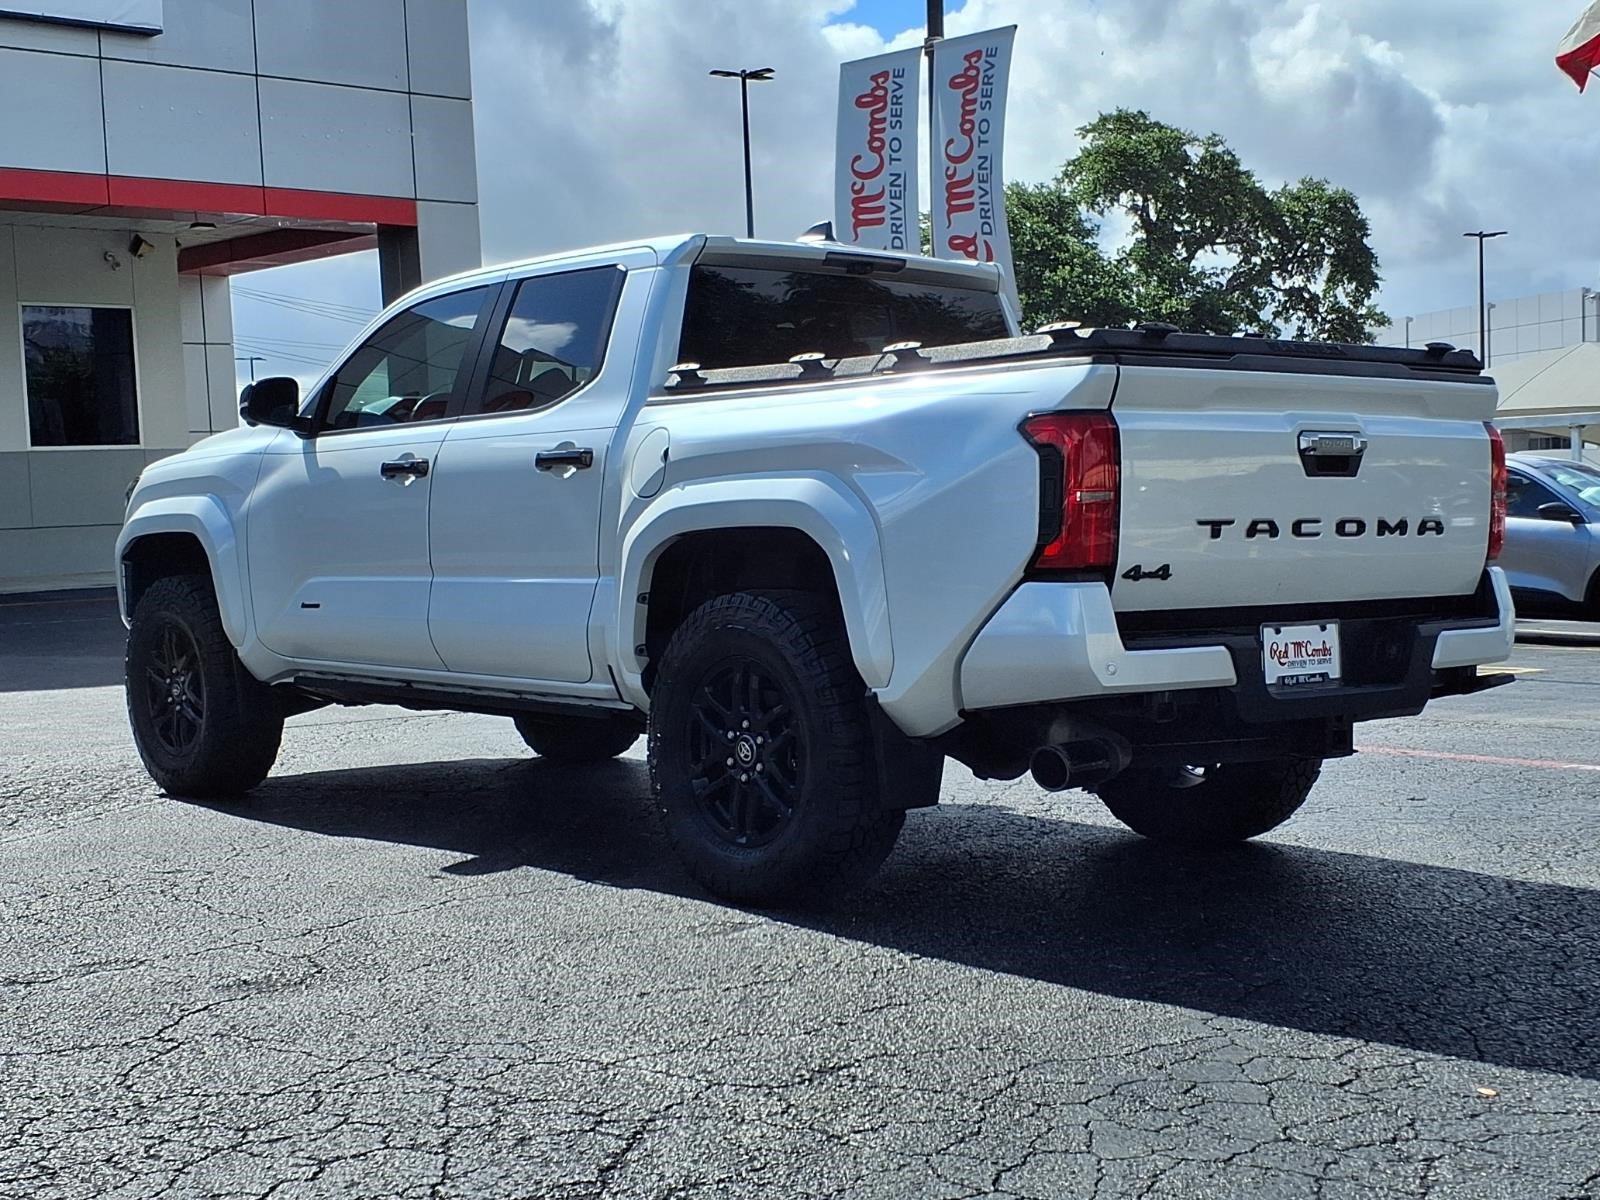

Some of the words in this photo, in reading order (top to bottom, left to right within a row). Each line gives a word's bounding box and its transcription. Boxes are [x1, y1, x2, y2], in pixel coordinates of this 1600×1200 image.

[980, 46, 998, 112] SERVE
[890, 67, 906, 131] SERVE
[977, 118, 993, 149] TO
[889, 137, 903, 166] TO
[890, 172, 905, 250] DRIVEN
[978, 155, 994, 237] DRIVEN
[1196, 518, 1445, 539] TACOMA
[1270, 641, 1290, 667] Red
[1287, 660, 1307, 668] DRIVEN
[1317, 658, 1332, 666] SERVE
